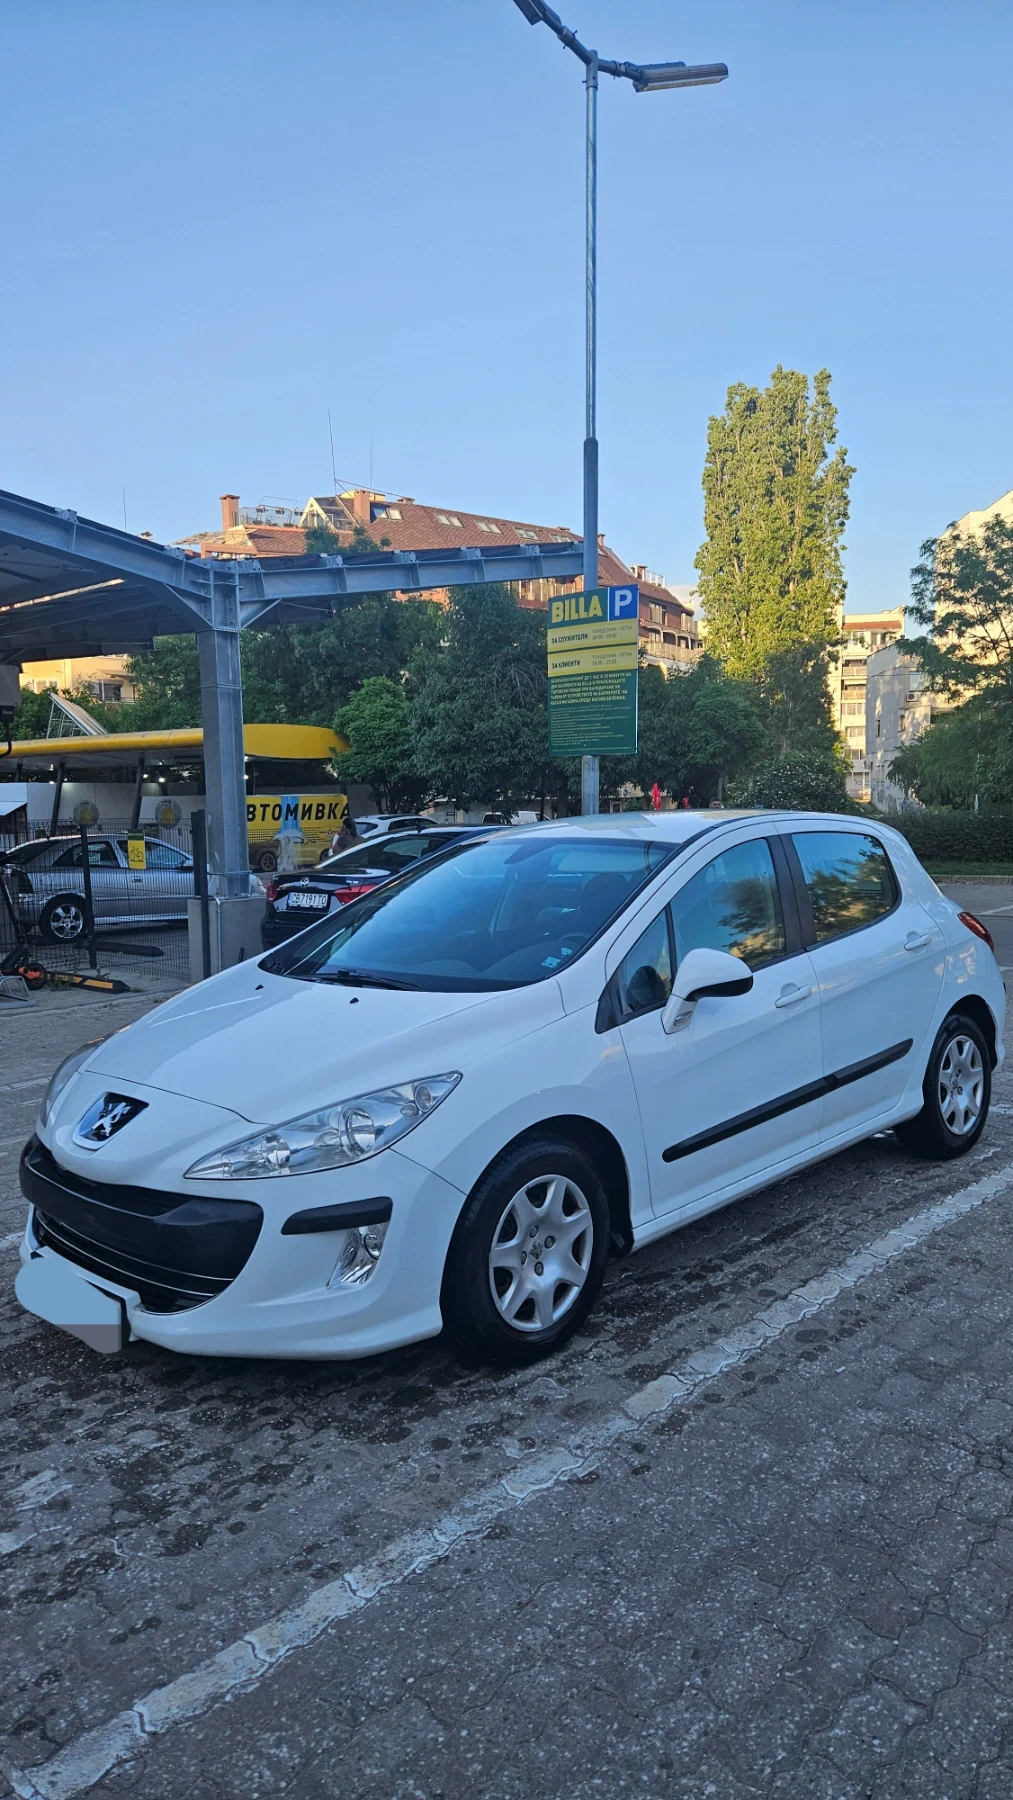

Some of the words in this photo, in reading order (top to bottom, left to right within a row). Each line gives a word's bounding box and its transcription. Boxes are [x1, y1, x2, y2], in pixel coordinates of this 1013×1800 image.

[552, 595, 602, 624] BILLA
[614, 589, 632, 616] P
[558, 633, 588, 642] СЛУЖИТЕЛИ
[558, 660, 580, 668] КЛИЕНТИ
[246, 802, 350, 822] ВТОМИВКА
